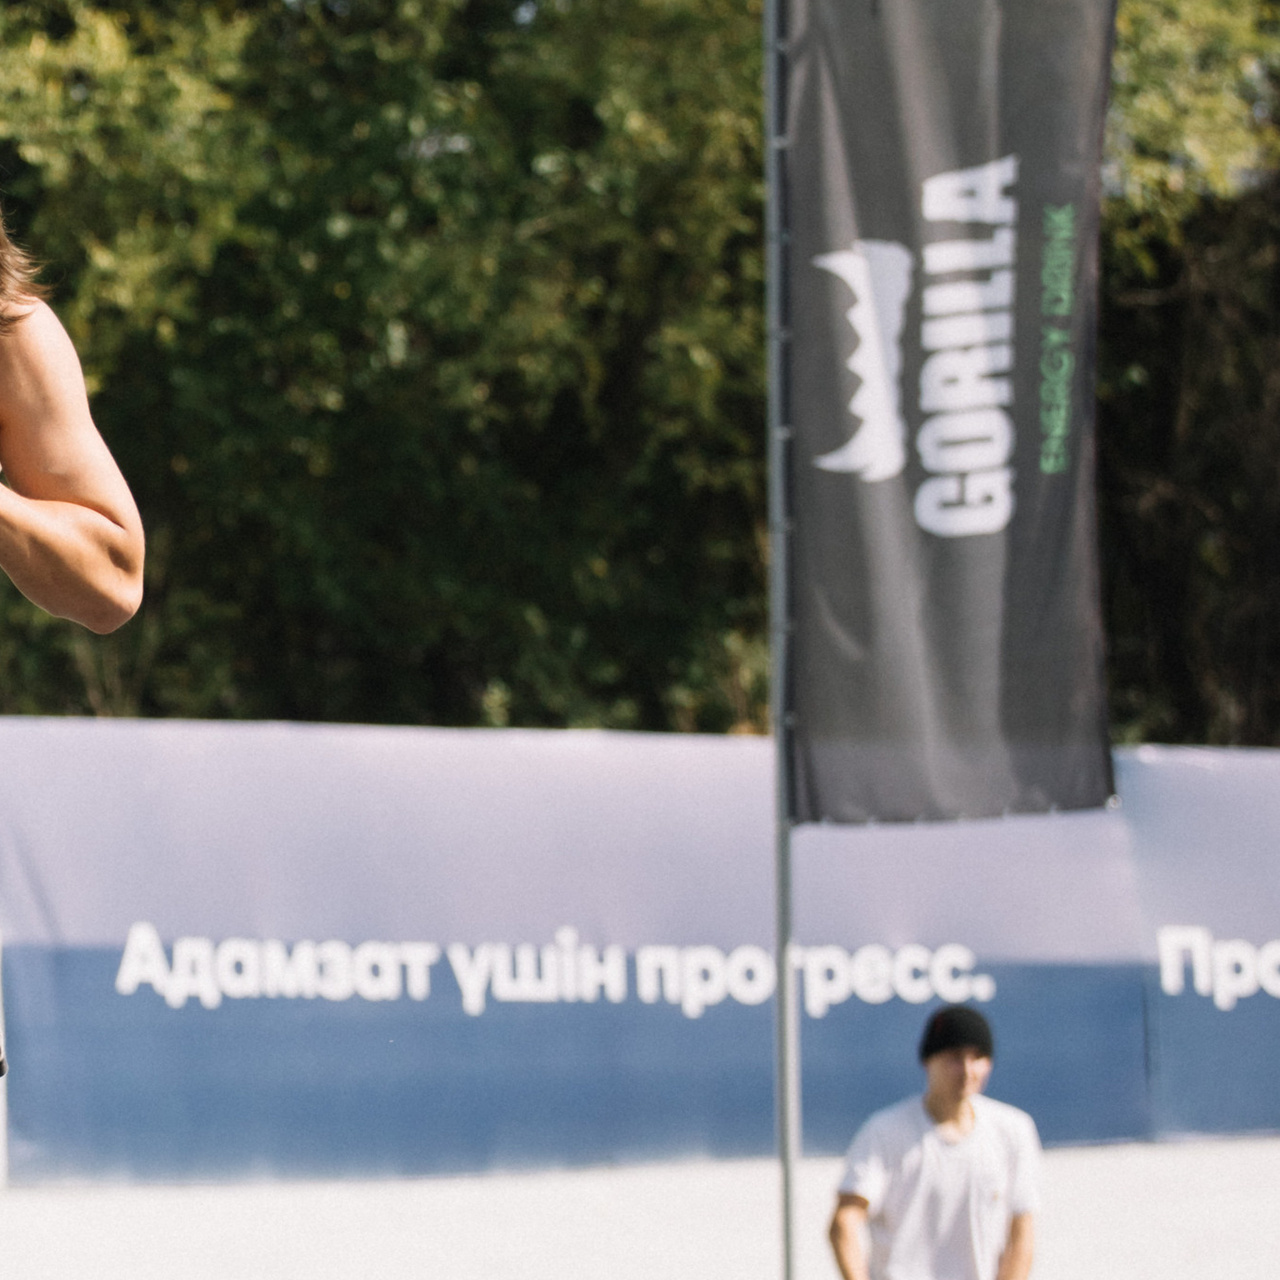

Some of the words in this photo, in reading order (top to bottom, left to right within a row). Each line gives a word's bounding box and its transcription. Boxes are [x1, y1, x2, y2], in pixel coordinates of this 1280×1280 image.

[1041, 202, 1075, 316] DRINK
[914, 153, 1020, 537] GORILLA
[1040, 327, 1075, 474] ENERGY
[116, 921, 441, 1010] Адамзат
